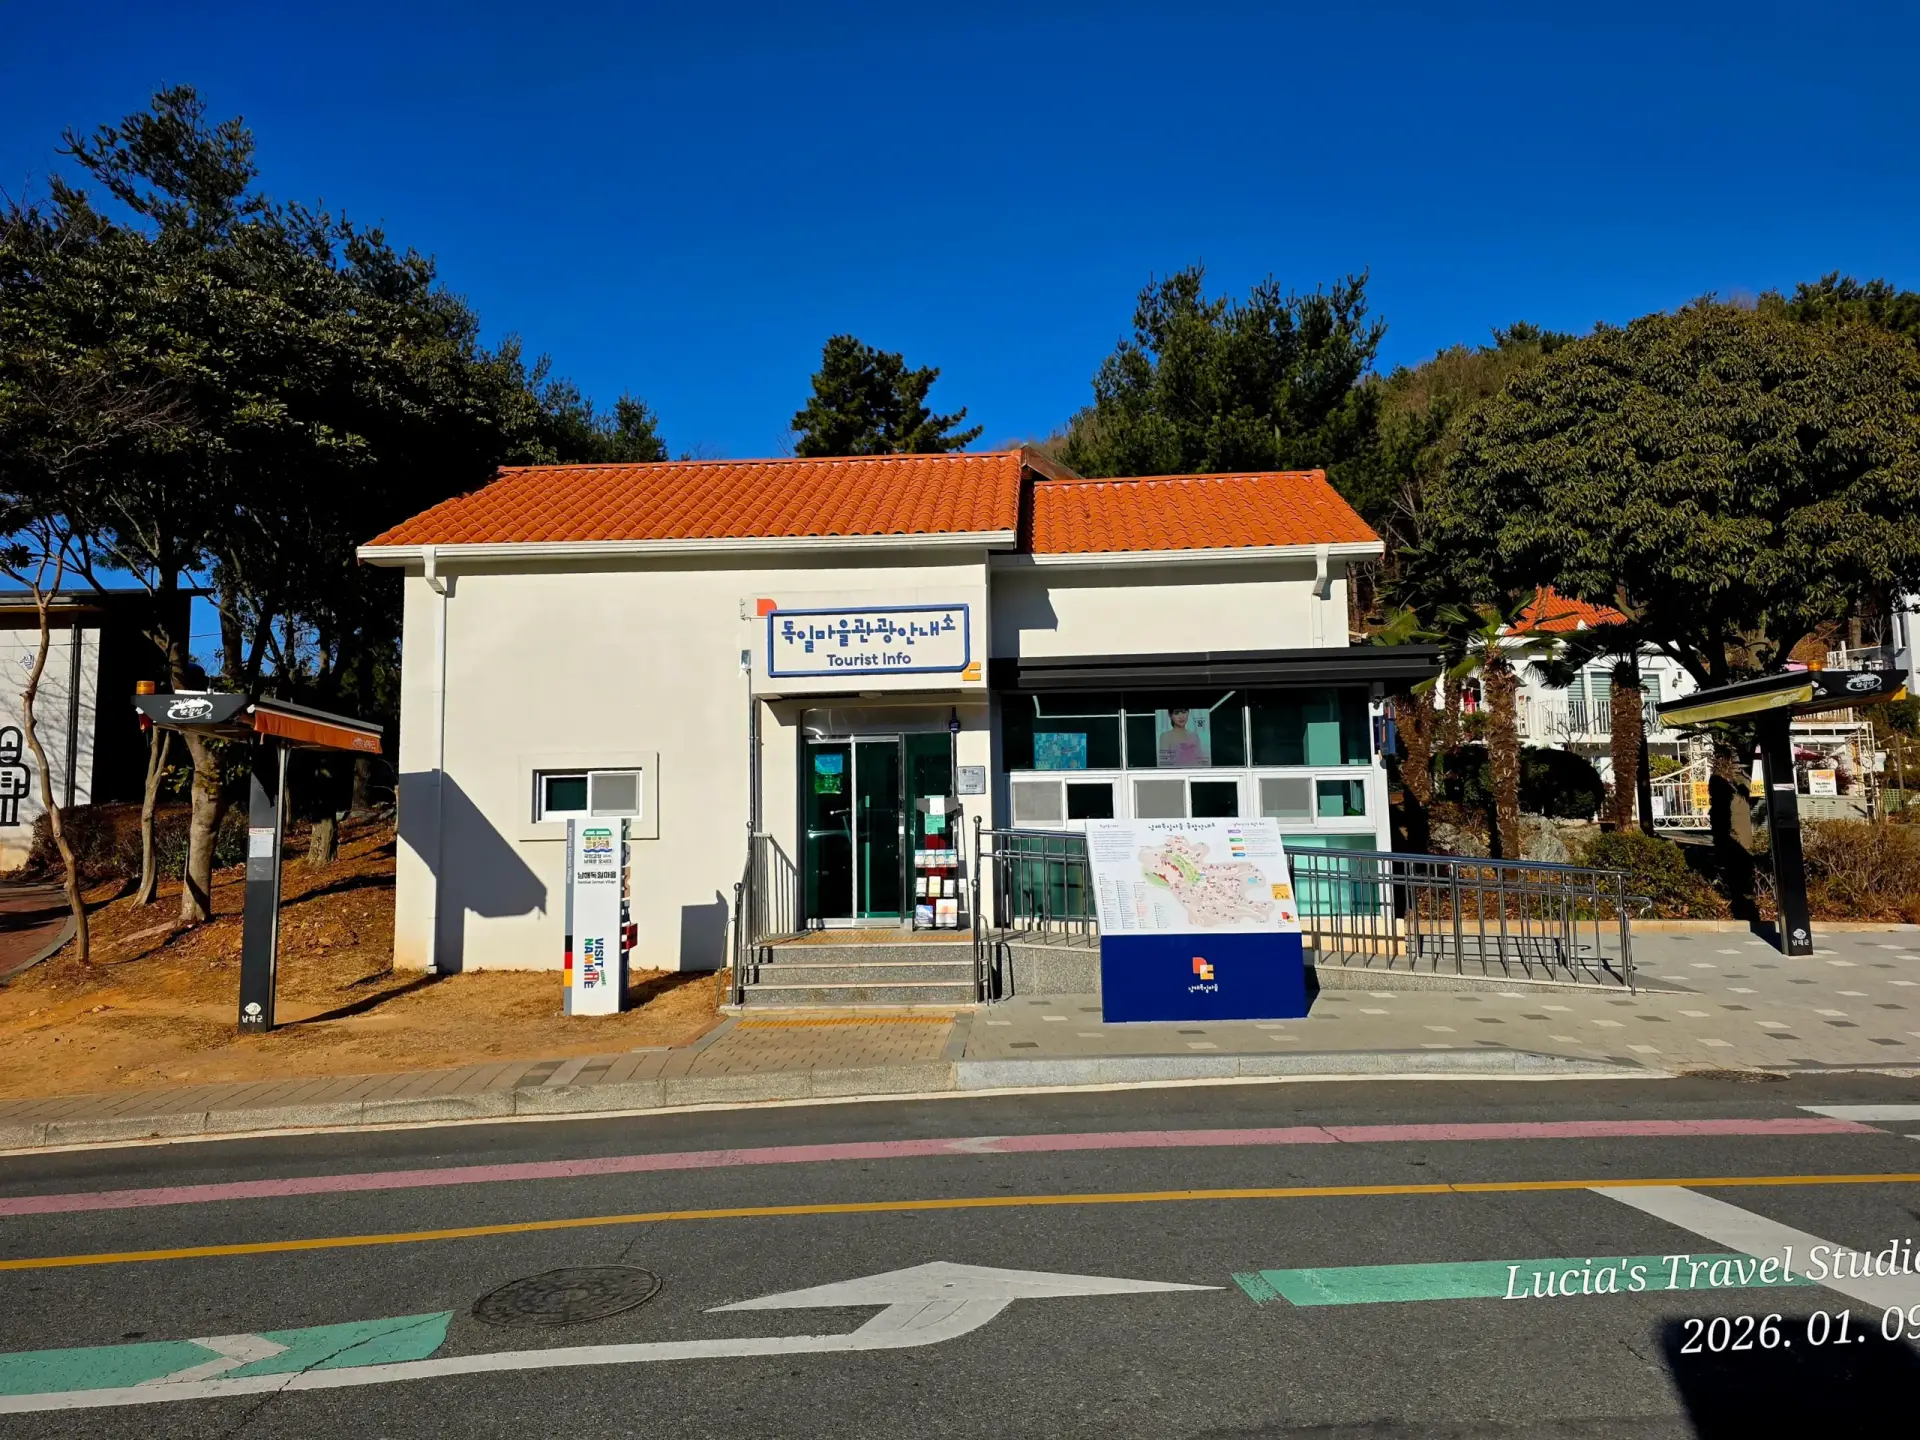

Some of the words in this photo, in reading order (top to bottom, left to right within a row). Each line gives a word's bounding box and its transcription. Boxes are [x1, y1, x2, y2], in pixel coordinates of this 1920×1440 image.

[781, 614, 956, 653] 독일마을관광안내소
[826, 652, 879, 667] Tourist
[882, 651, 912, 665] Info
[577, 871, 617, 879] 남해독일마을
[584, 938, 600, 989] NAMHAE
[594, 937, 604, 968] VISIT
